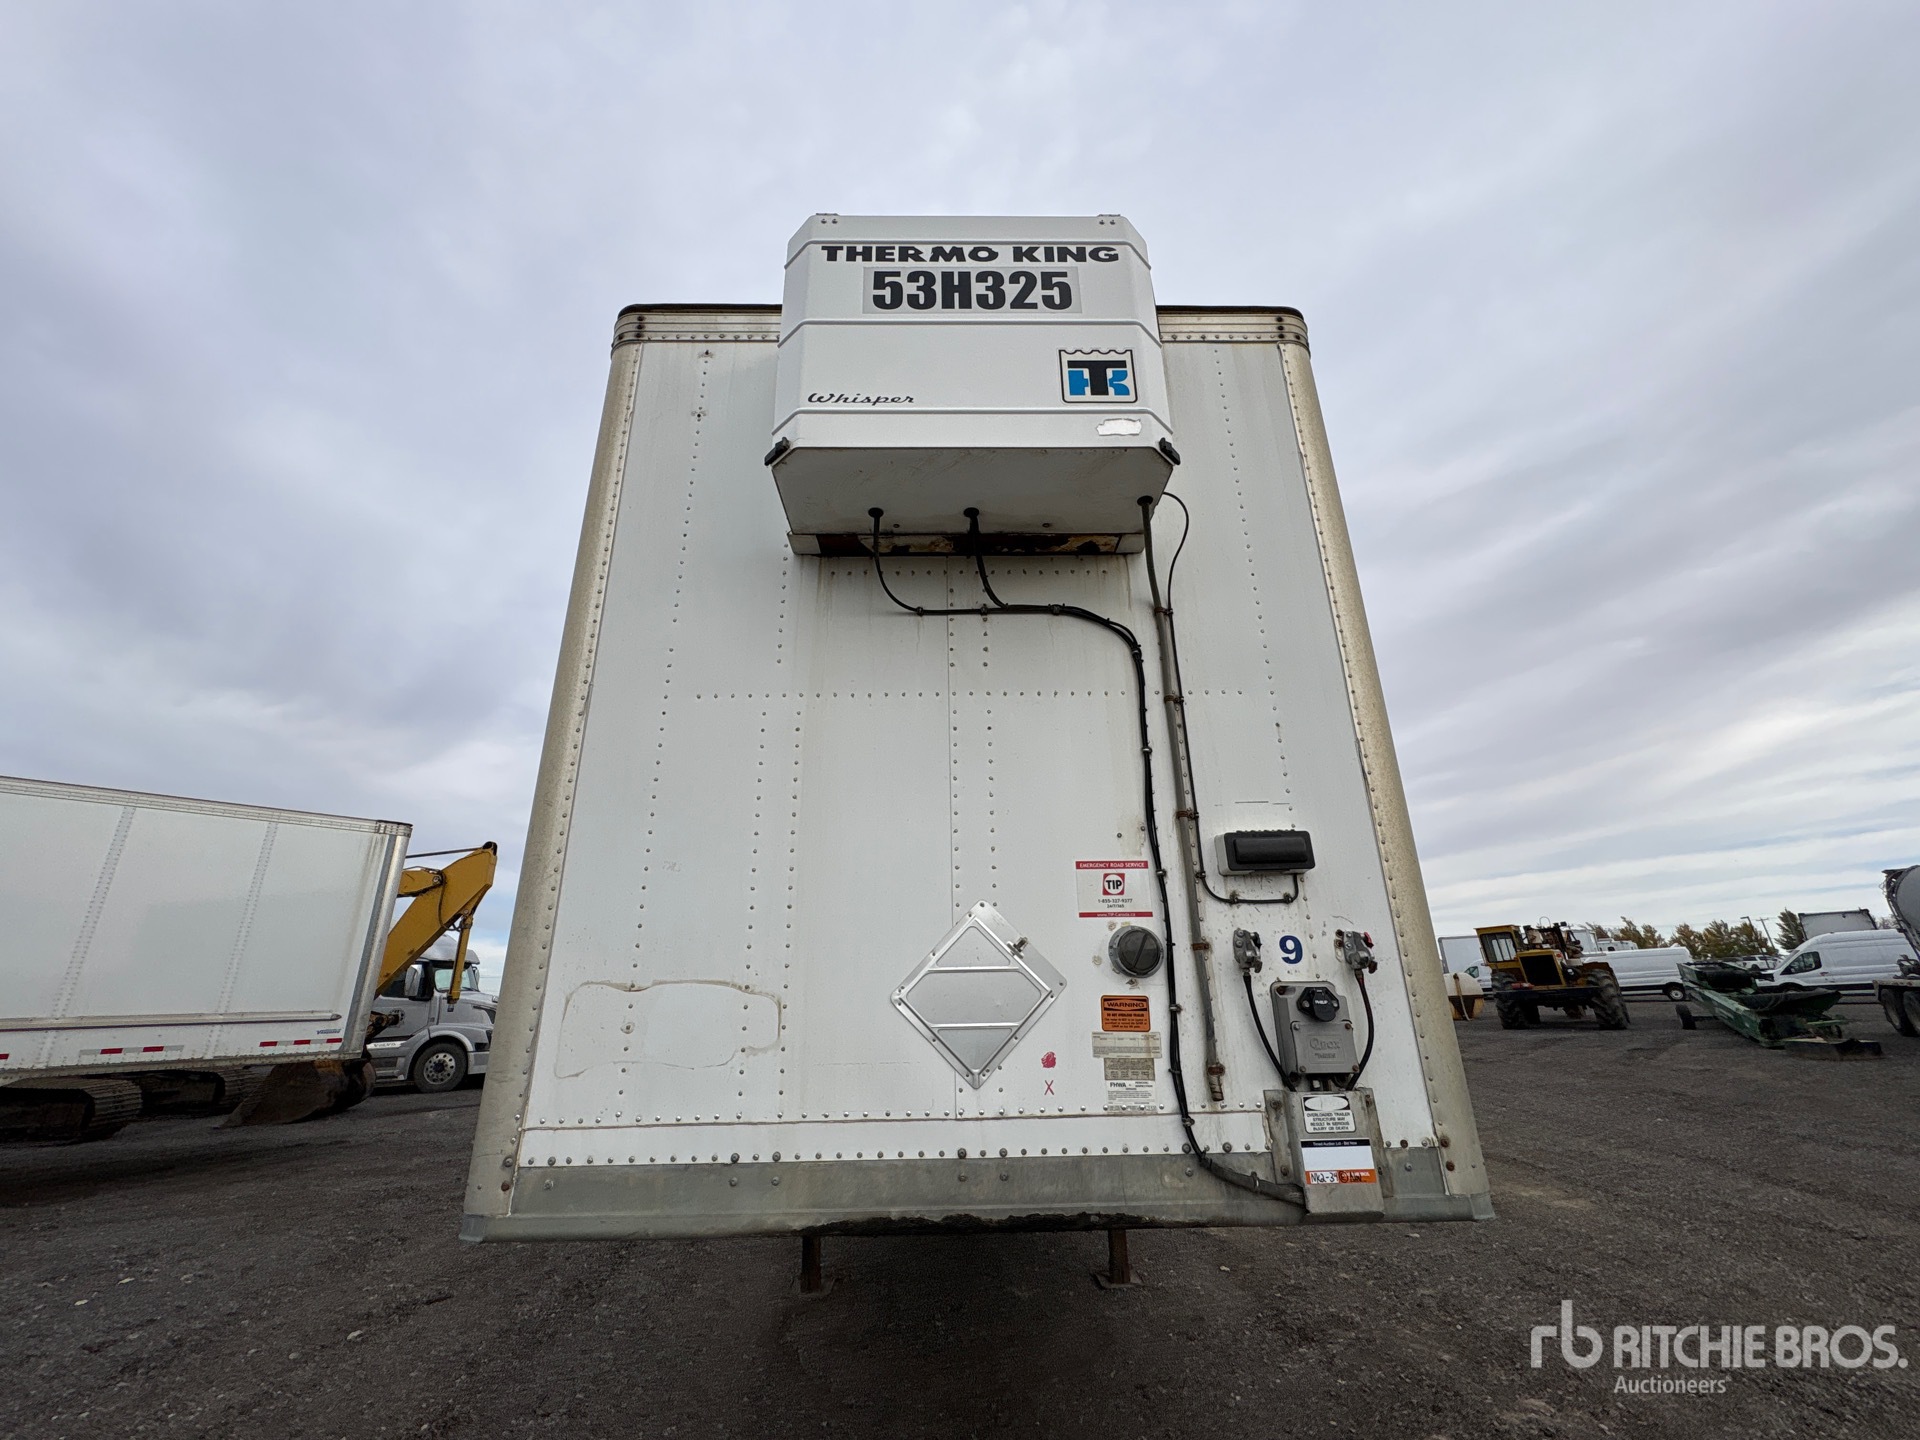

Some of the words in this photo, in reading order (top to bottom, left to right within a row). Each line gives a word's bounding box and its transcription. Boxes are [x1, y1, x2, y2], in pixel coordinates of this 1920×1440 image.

[821, 245, 998, 262] THERMO
[1012, 246, 1119, 263] KING
[872, 270, 1073, 310] 53H325
[807, 392, 914, 406] Whisper
[1105, 880, 1122, 890] TIP
[1279, 935, 1303, 964] 9
